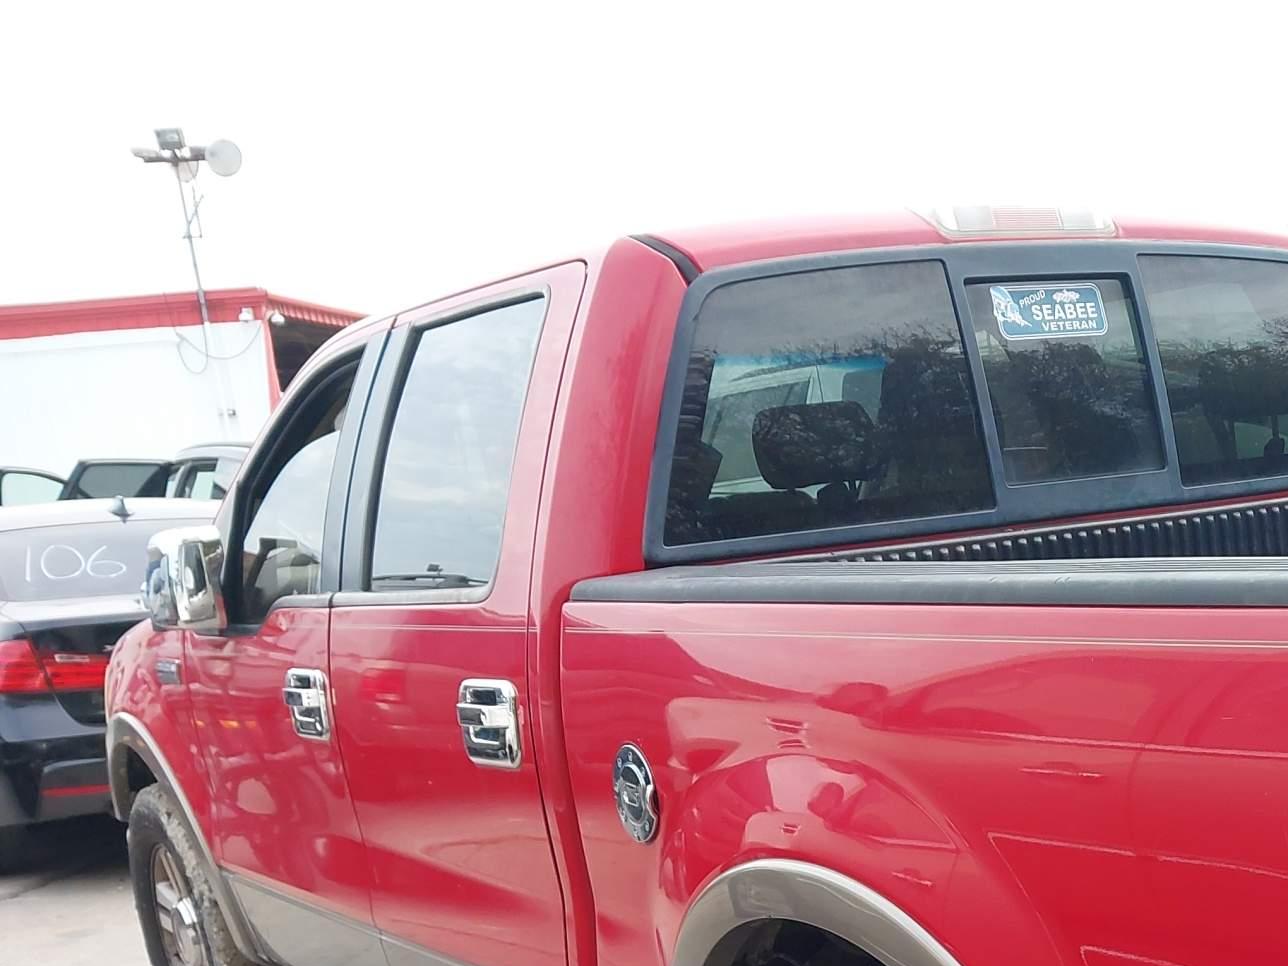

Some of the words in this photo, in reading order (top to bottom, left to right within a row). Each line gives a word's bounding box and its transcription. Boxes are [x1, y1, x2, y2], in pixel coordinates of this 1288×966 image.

[1019, 289, 1046, 309] PROUD
[1031, 302, 1098, 321] SEABEE
[1041, 319, 1097, 331] VETERAN
[25, 544, 127, 582] 106
